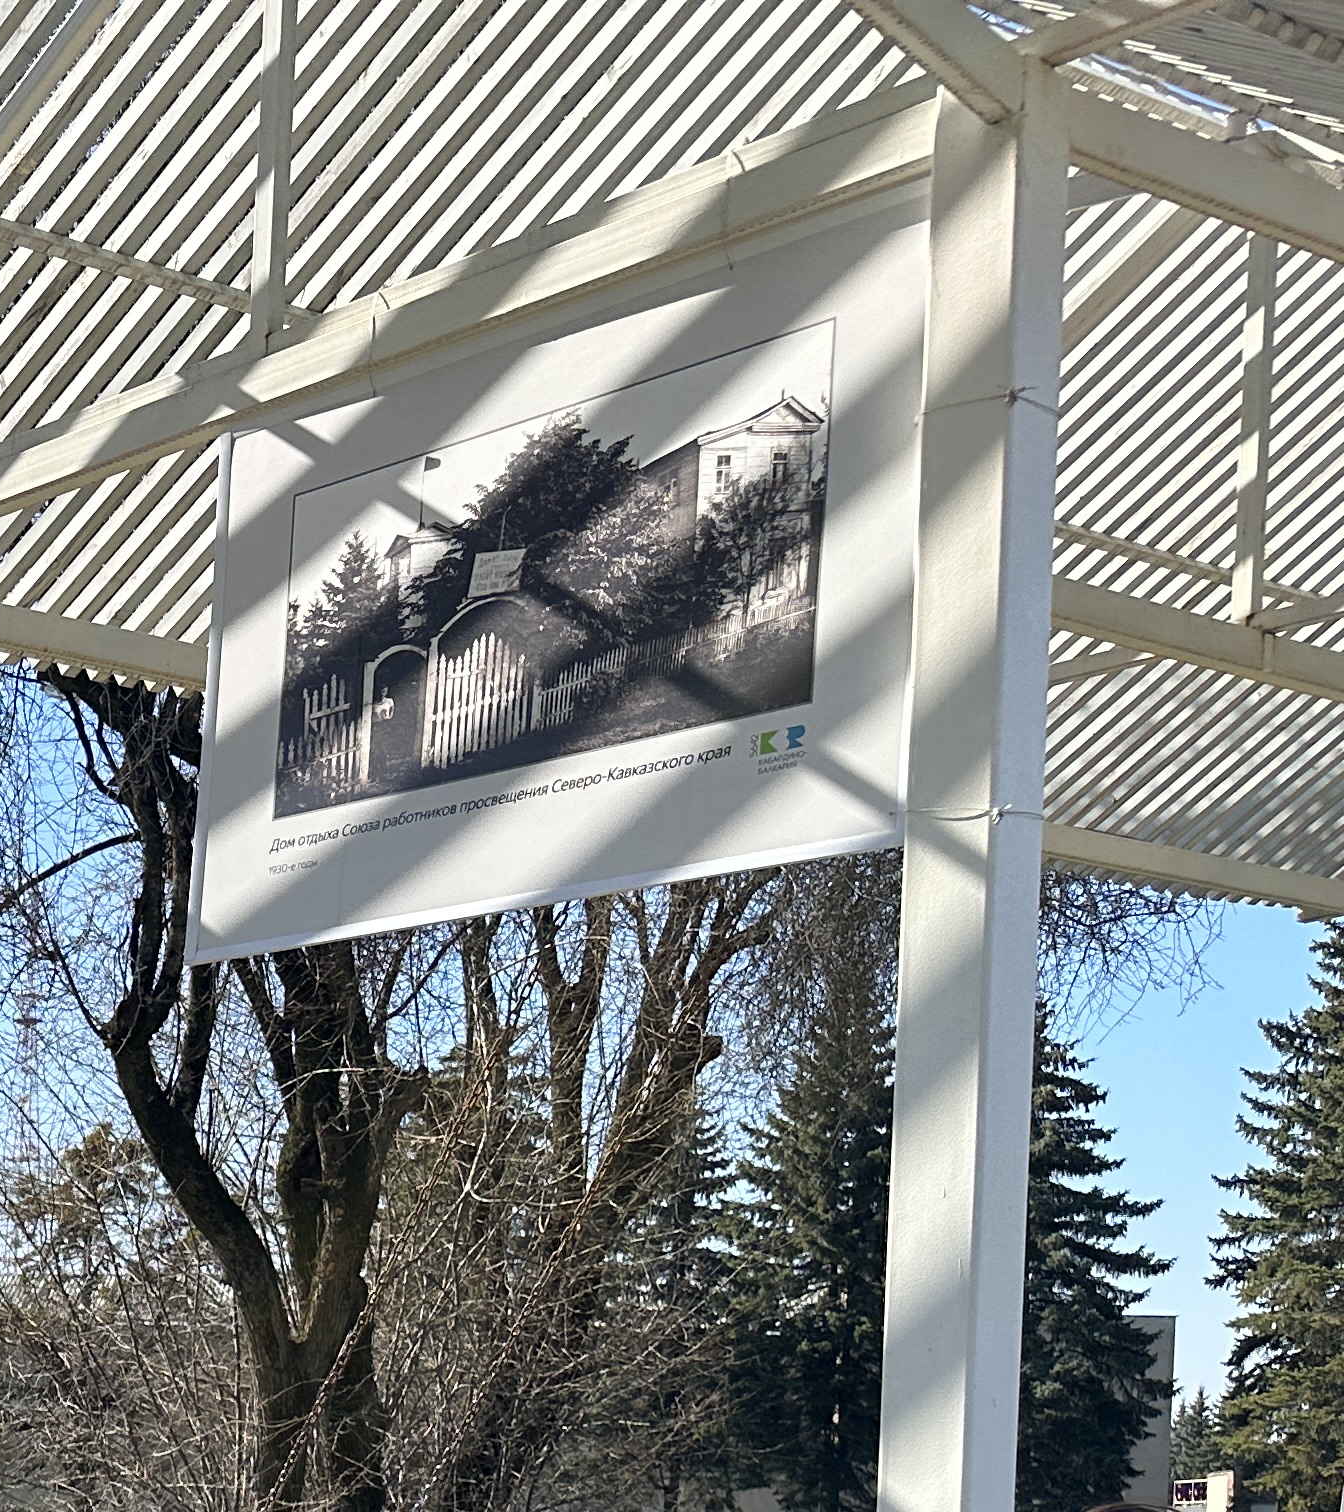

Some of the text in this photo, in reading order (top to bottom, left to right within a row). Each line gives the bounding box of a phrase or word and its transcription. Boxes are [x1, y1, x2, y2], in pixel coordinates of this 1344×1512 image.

[269, 745, 732, 854] Дом отдыха Союза работников просвещения Северо-Кавказского края
[269, 859, 318, 875] 1930-е годы
